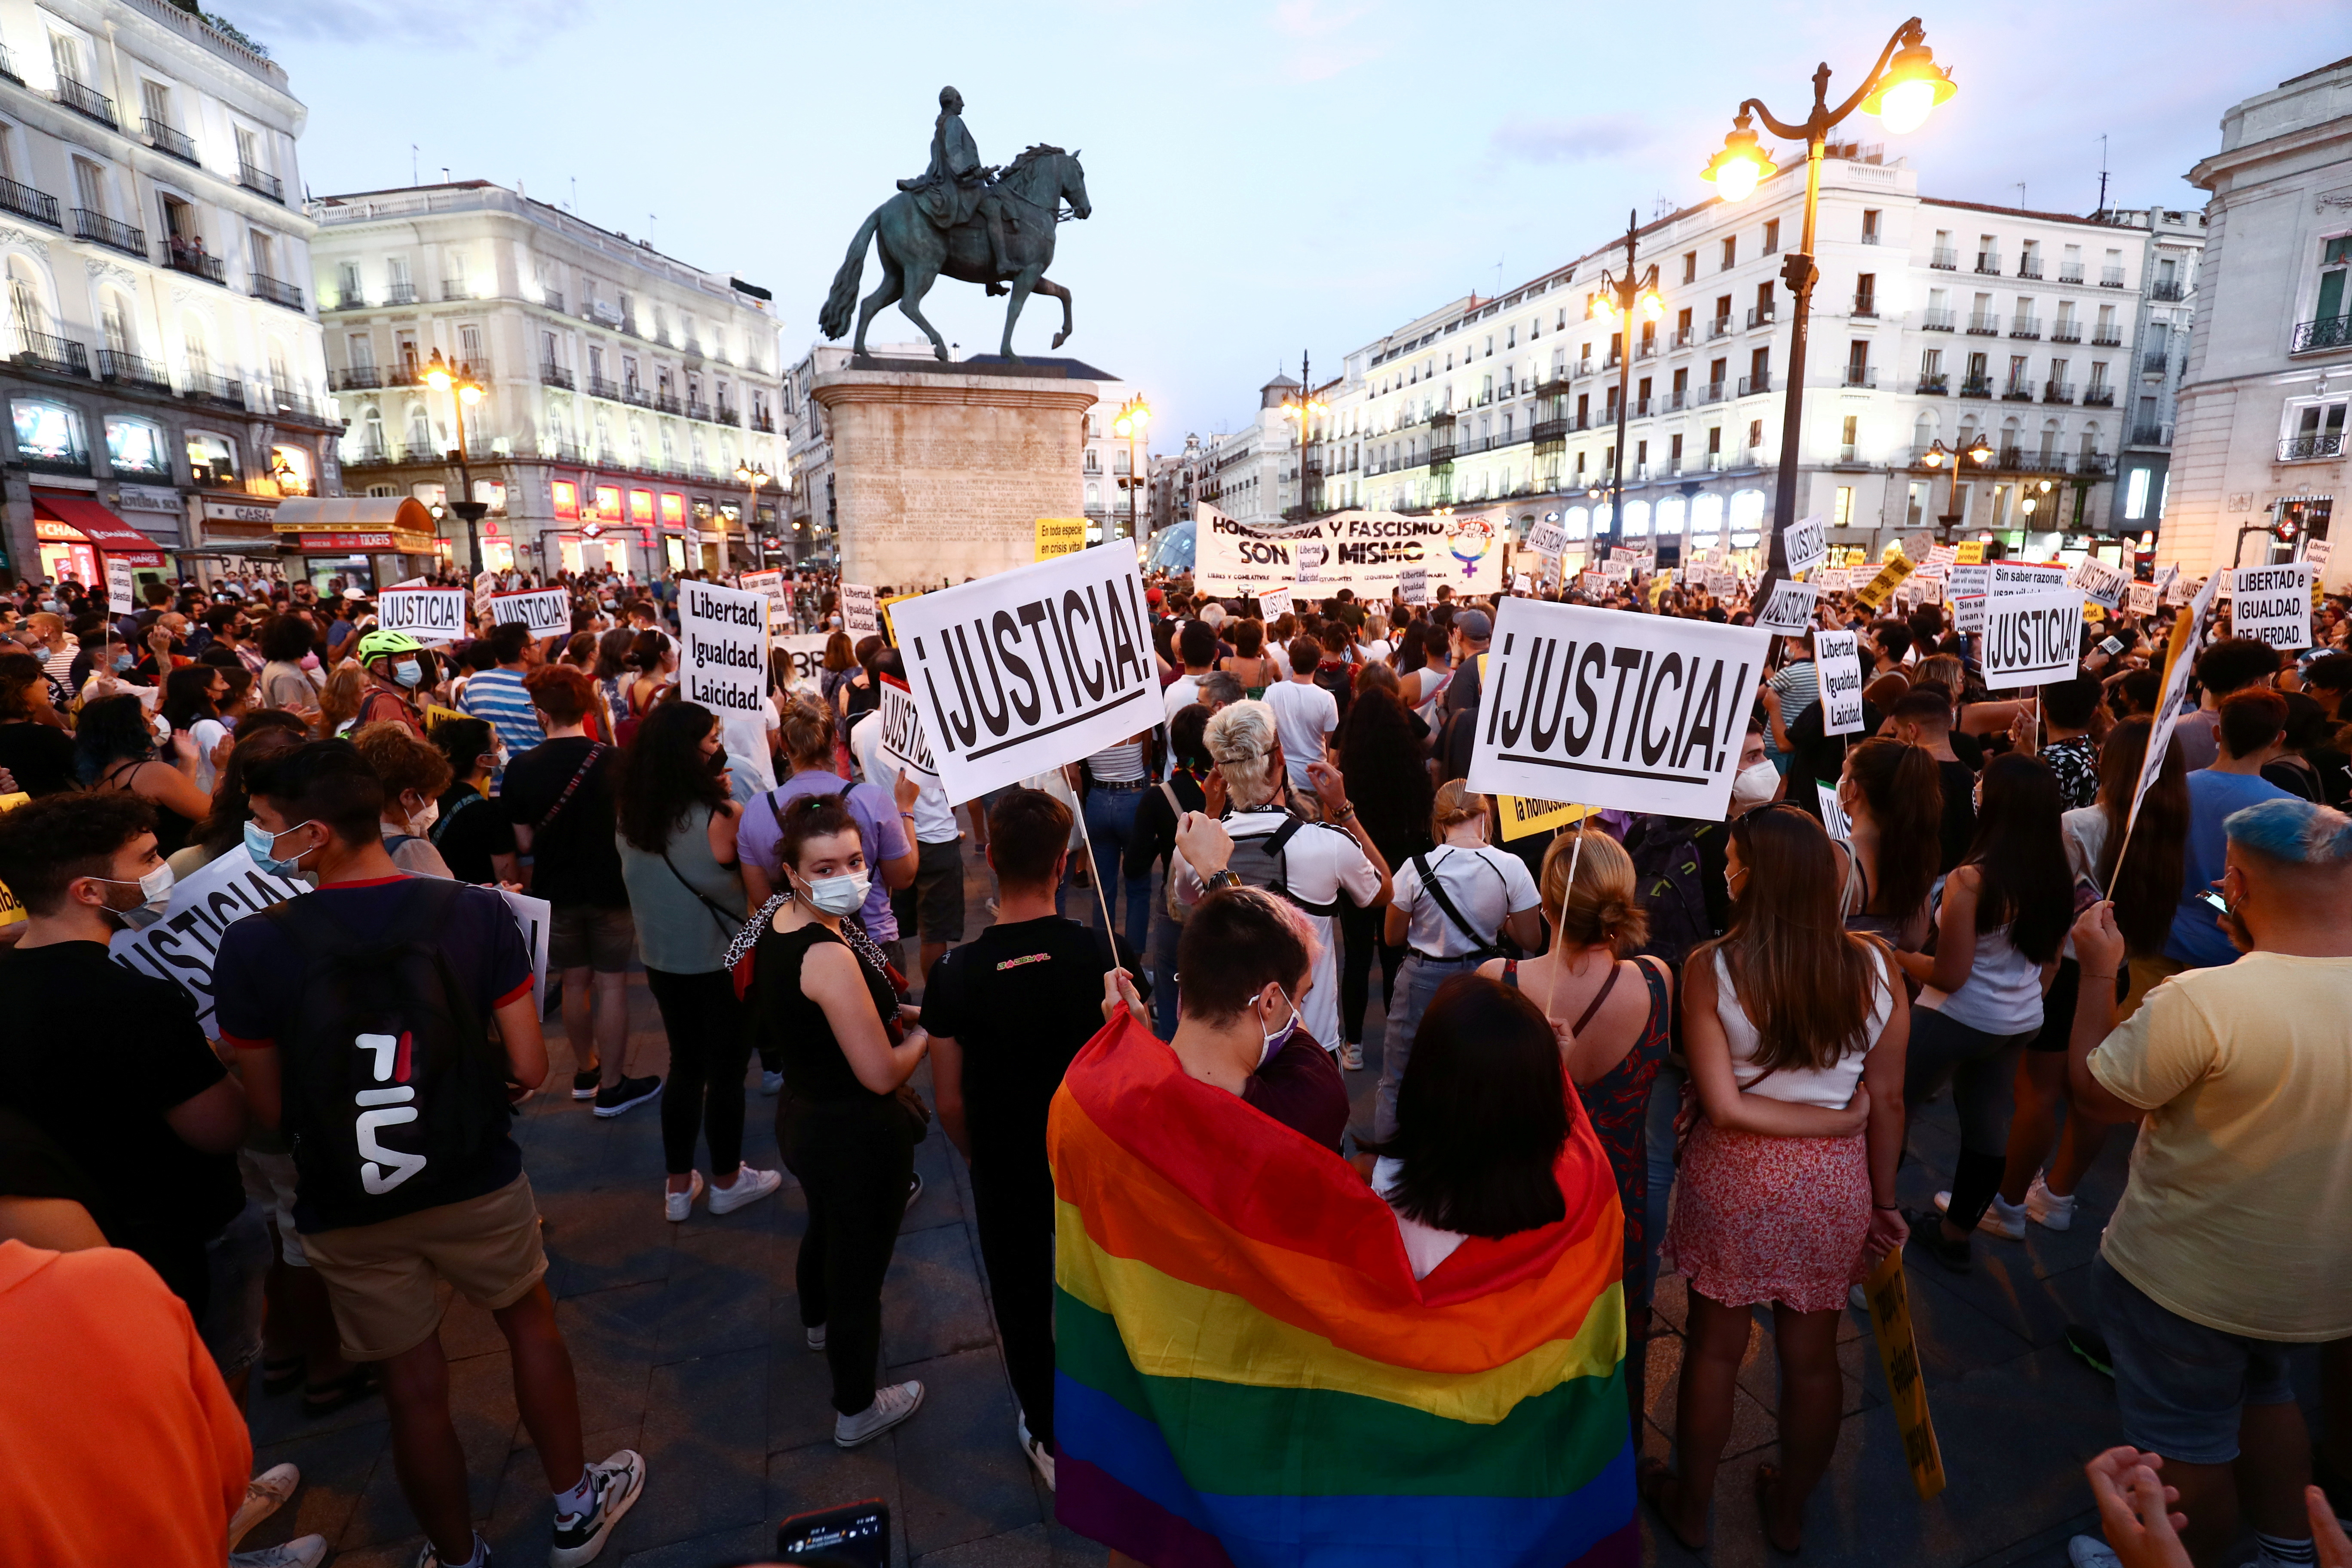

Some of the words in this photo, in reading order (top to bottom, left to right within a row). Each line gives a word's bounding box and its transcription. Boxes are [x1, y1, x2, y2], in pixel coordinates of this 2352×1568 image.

[46, 523, 83, 536] CHAN
[358, 534, 390, 545] TICKETS
[1042, 525, 1049, 536] En
[1050, 524, 1061, 536] toda
[1062, 524, 1082, 538] especie
[1329, 521, 1343, 537] Y
[1349, 521, 1444, 538] FASCISMO
[1530, 525, 1567, 551] ¡JUSTICIA!
[1041, 545, 1049, 554] en
[1050, 542, 1067, 553] crisis
[1069, 541, 1082, 552] vital
[1238, 541, 1290, 565] SON
[1338, 541, 1425, 565] MISMO
[1300, 545, 1321, 555] Libertad,
[1786, 520, 1825, 564] ¡JUSTICIA!
[2310, 542, 2330, 553] Libertad,
[2306, 553, 2326, 564] Igualdad,
[1402, 570, 1426, 579] Libertad,
[1996, 568, 2008, 581] Sin
[2011, 570, 2032, 583] saber
[2034, 573, 2063, 587] razonar,
[2074, 562, 2125, 600] ¡JUSTICIA!
[2239, 570, 2295, 592] LIBERTAD
[2297, 573, 2304, 586] e
[844, 587, 873, 601] Libertad,
[1402, 583, 1426, 593] Igualdad,
[2130, 584, 2156, 608] ¡JUSTICIA!
[382, 595, 459, 628] ¡JUSTICIA!
[495, 594, 568, 626] ¡JUSTICIA!
[690, 589, 763, 633] Libertad,
[770, 603, 784, 612] estias
[846, 603, 874, 618] Igualdad,
[1763, 588, 1815, 625] ¡JUSTICIA!
[1959, 601, 1972, 609] Sin
[2083, 609, 2099, 618] ertad.
[2238, 597, 2303, 619] IGUALDAD,
[848, 618, 876, 631] Laicidad.
[1960, 612, 1980, 621] usan
[1987, 606, 2079, 669] ¡JUSTICIA!
[2238, 628, 2252, 640] DE
[2255, 625, 2302, 645] VERDAD.
[691, 632, 763, 675] Igualdad,
[1820, 638, 1856, 660] Libertad,
[913, 573, 1150, 753] ¡JUSTICIA!
[691, 674, 763, 711] Laicidad.
[1826, 671, 1860, 697] Igualdad,
[1486, 633, 1749, 773] ¡JUSTICIA!
[1831, 705, 1862, 728] Laicidad.
[1514, 796, 1525, 822] la
[355, 1030, 427, 1194] FILA
